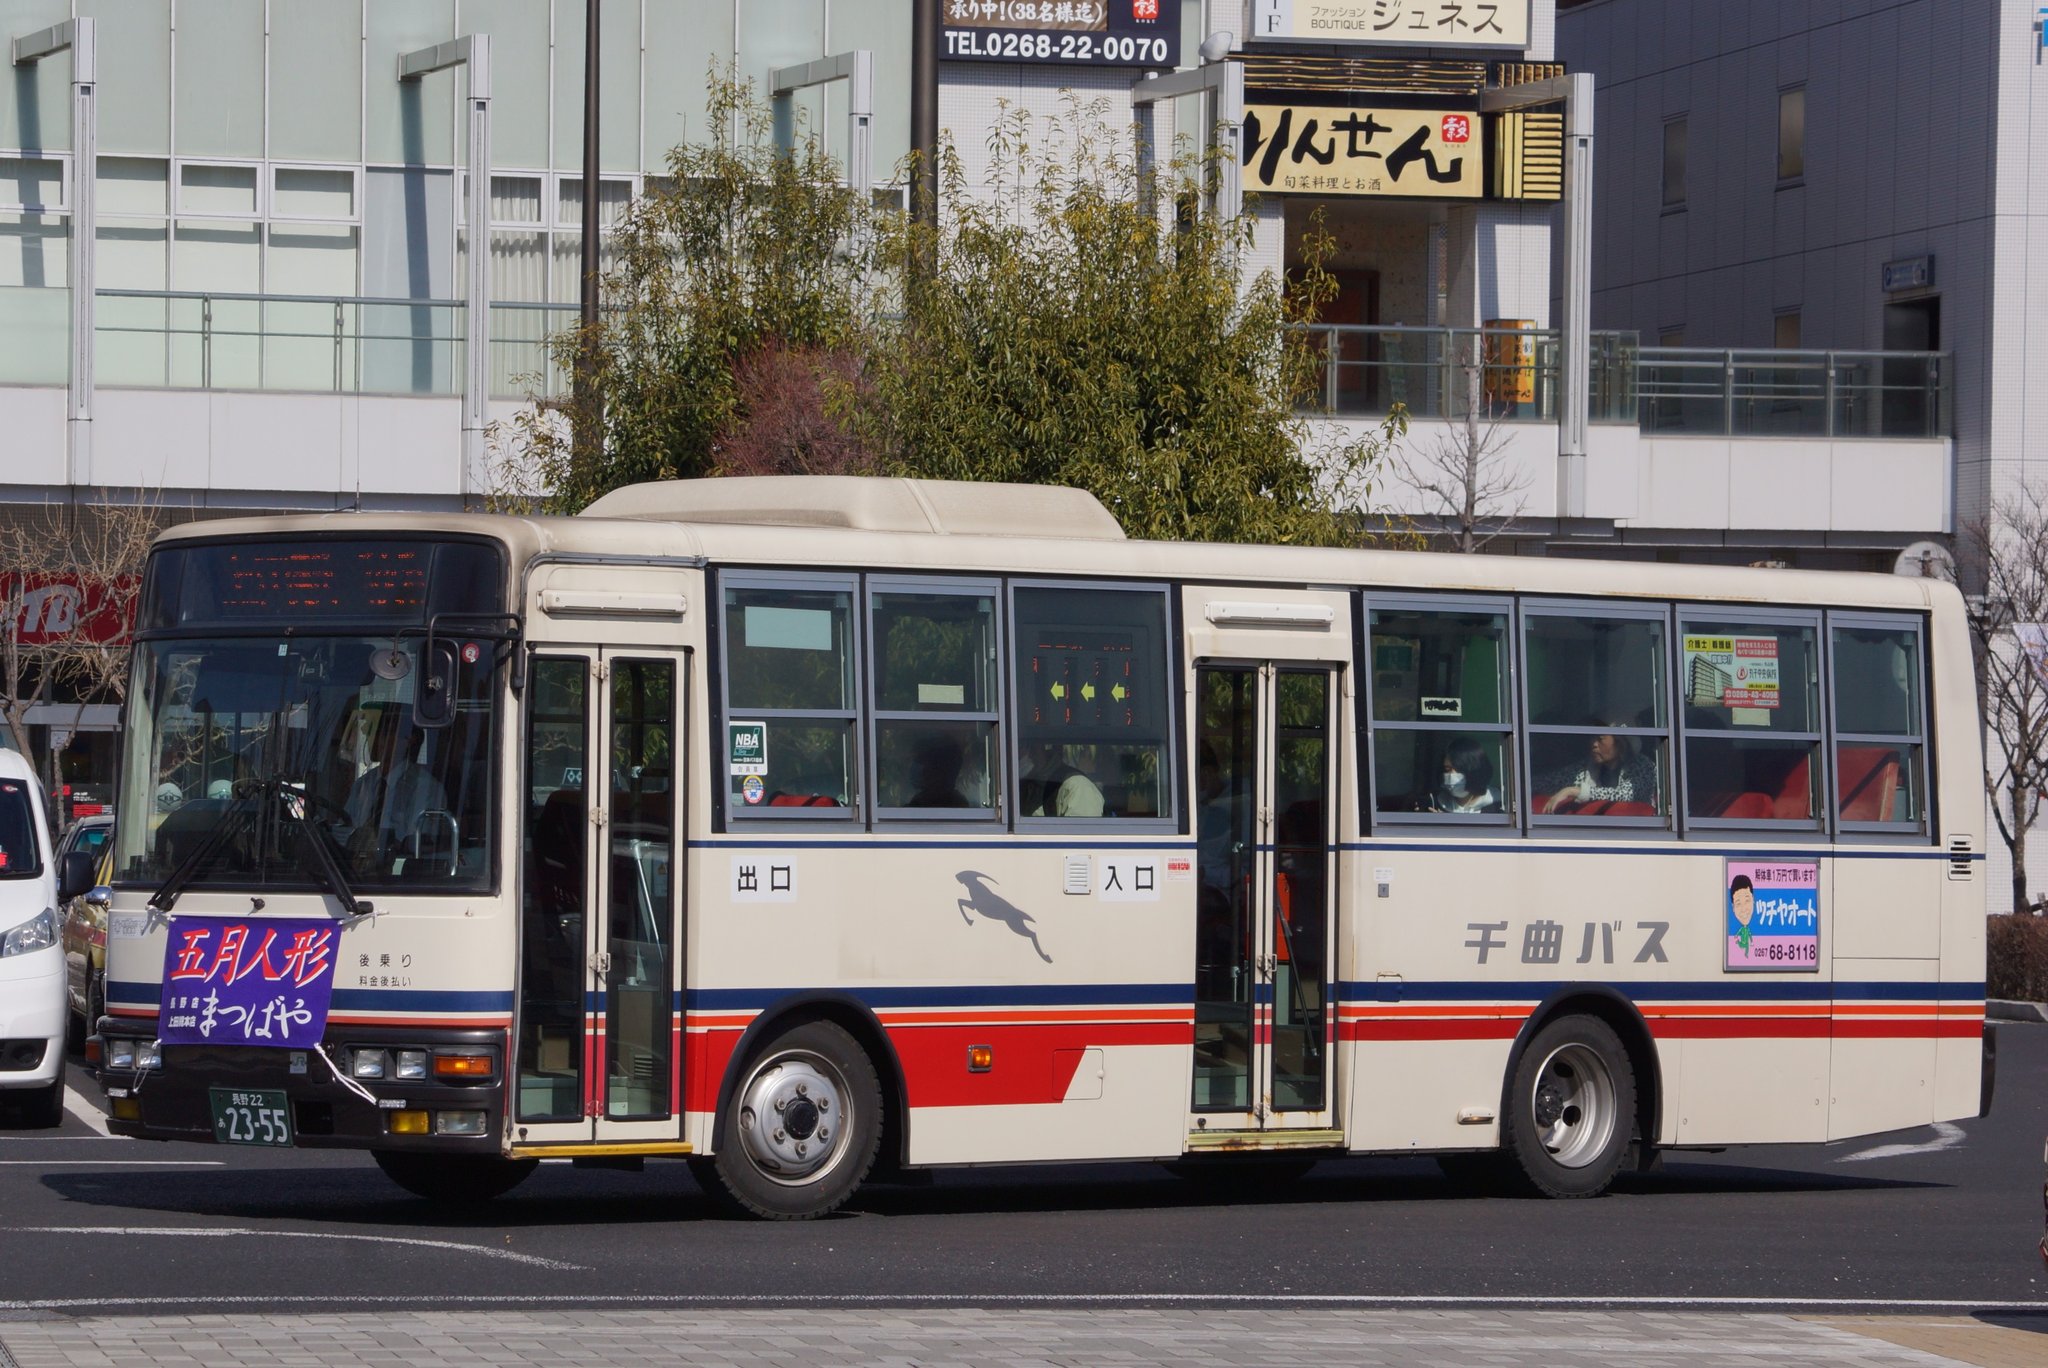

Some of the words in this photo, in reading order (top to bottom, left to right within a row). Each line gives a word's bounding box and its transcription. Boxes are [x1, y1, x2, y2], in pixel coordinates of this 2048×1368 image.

[1310, 6, 1366, 18] ファッション
[1311, 19, 1365, 30] BOUTIQUE
[1373, 0, 1502, 34] ジュネス
[945, 30, 1168, 62] TEL.0268-22-0070
[1284, 175, 1381, 191] 旬菜料理とお酒
[736, 733, 759, 746] NBA
[738, 865, 791, 892] 出口
[1105, 865, 1154, 891] 入口
[1756, 898, 1817, 927] ツチヤオート
[1464, 919, 1670, 965] 千曲バス
[1769, 944, 1816, 960] 68-8118
[170, 924, 332, 989] 五月人形
[360, 953, 411, 968] 後乗り
[359, 975, 411, 987] 料金後払い
[200, 988, 312, 1038] まつばや
